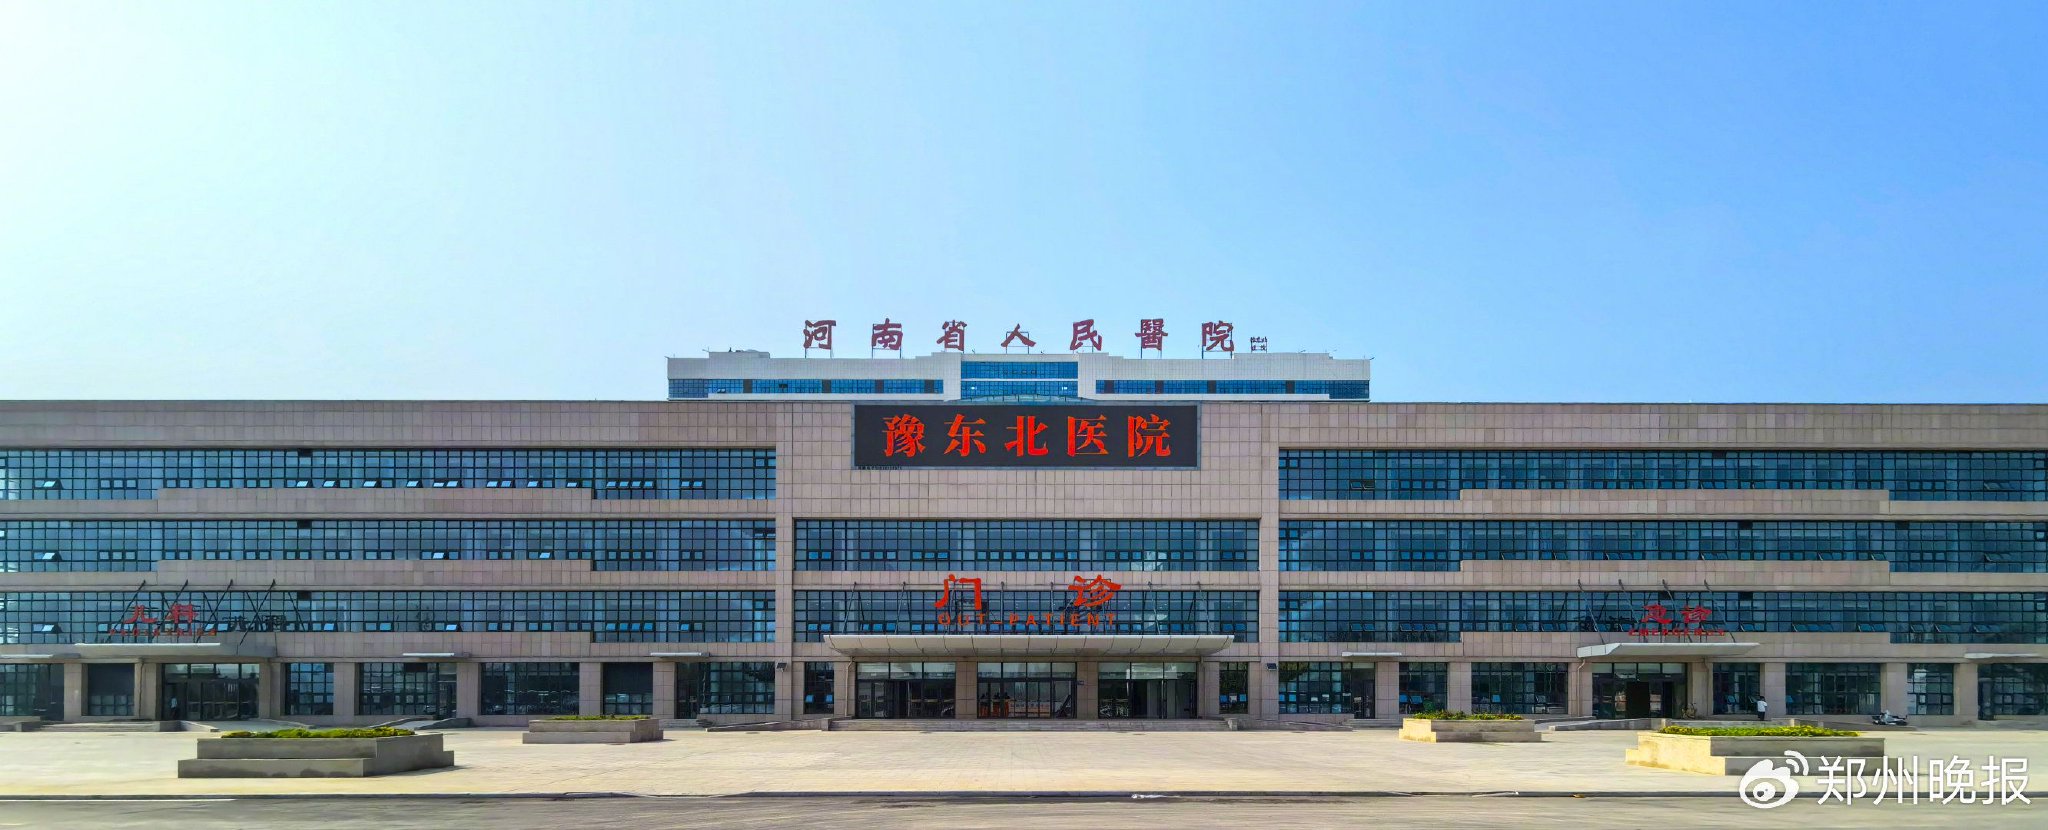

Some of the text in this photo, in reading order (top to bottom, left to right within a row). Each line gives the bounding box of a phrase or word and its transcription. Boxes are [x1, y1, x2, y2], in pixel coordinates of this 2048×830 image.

[803, 318, 1235, 352] 河南省人民醫院
[881, 413, 1172, 458] 豫东北医院
[933, 573, 1122, 610] 门诊
